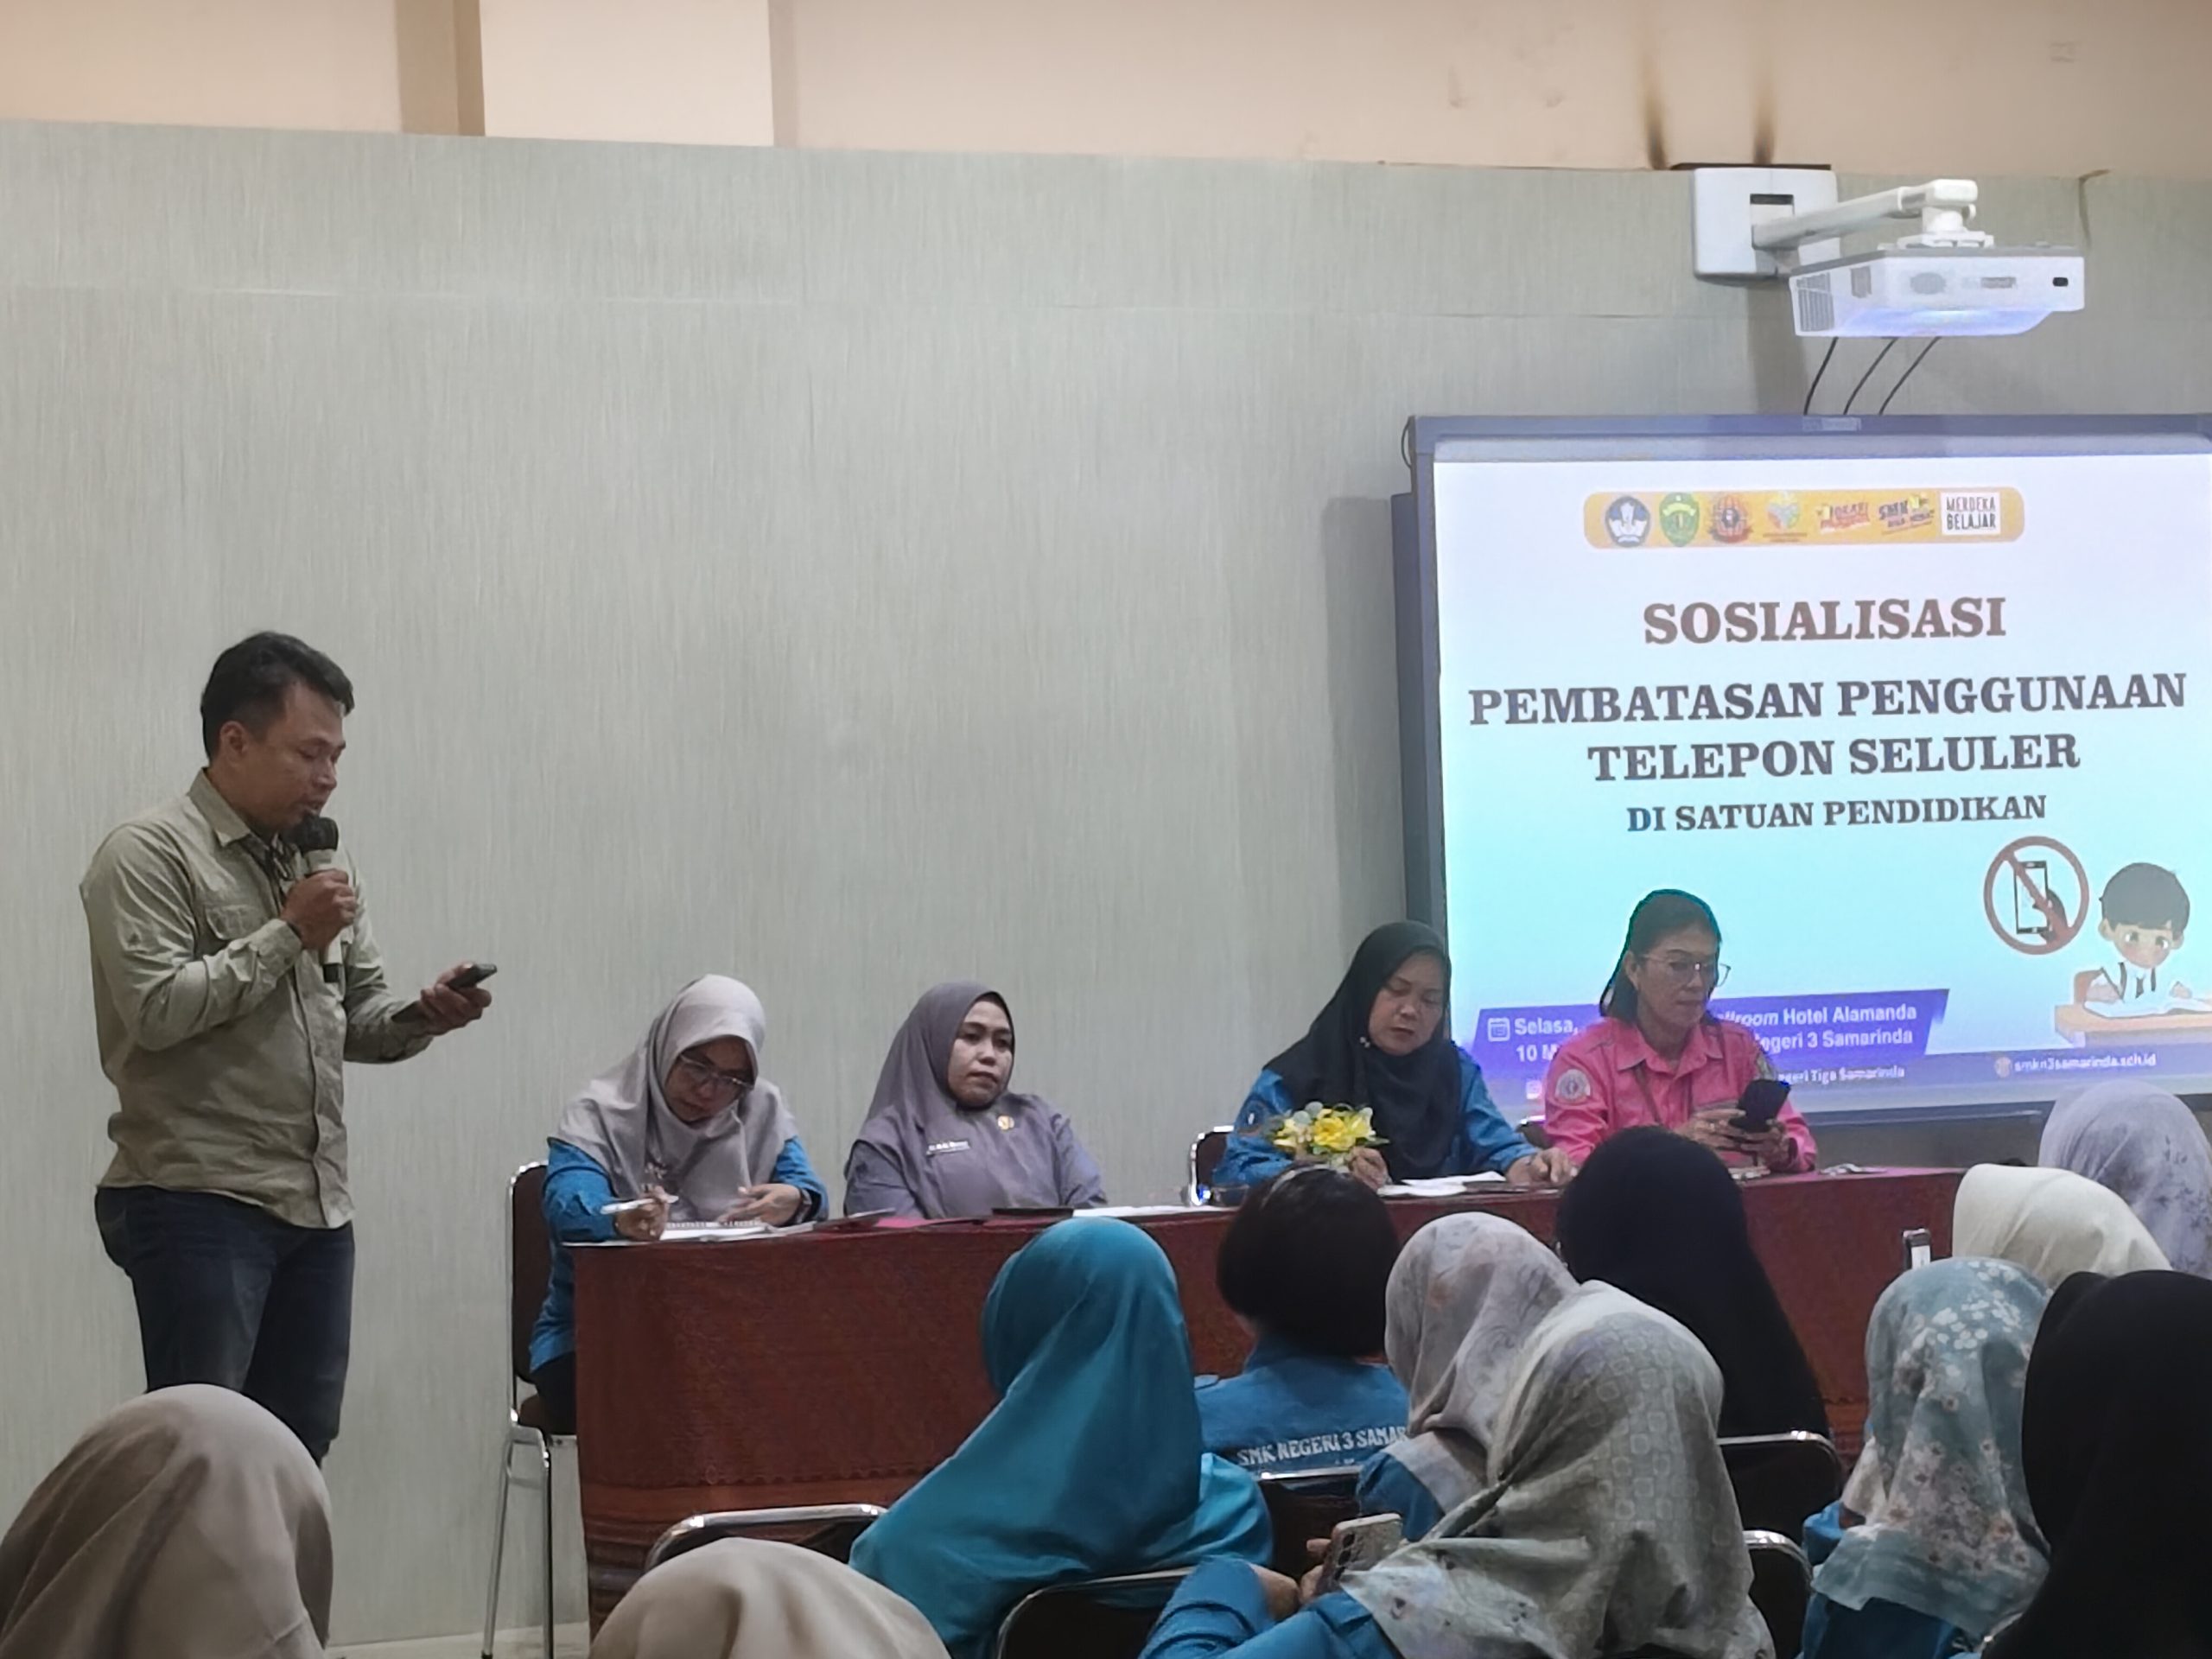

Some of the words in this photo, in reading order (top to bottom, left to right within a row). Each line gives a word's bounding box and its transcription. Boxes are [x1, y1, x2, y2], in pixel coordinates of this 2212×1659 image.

[1946, 496, 1997, 512] MERDEKA
[1946, 512, 1997, 531] BELAJAR
[1644, 597, 2007, 645] SOSIALISASI
[1469, 682, 1825, 726] PEMBATASAN
[1838, 673, 2187, 717] PENGGUNAAN
[1587, 740, 1836, 782] TELEPON
[1848, 734, 2082, 776] SELULER
[1627, 807, 1667, 833] DI
[1675, 802, 1815, 832] SATUAN
[1823, 795, 2048, 827] PENDIDIKAN
[1783, 1007, 1829, 1026] Hotel
[1833, 1003, 1918, 1024] Alamanda
[1516, 1044, 1538, 1063] 10
[1755, 1032, 1803, 1053] egeri
[1808, 1031, 1819, 1048] 3
[1821, 1028, 1914, 1048] Samarinda
[1236, 1445, 1277, 1466] SMK
[1277, 1436, 1341, 1459] NEGERI
[1342, 1432, 1355, 1450] 3
[1355, 1426, 1408, 1448] SAMAR
